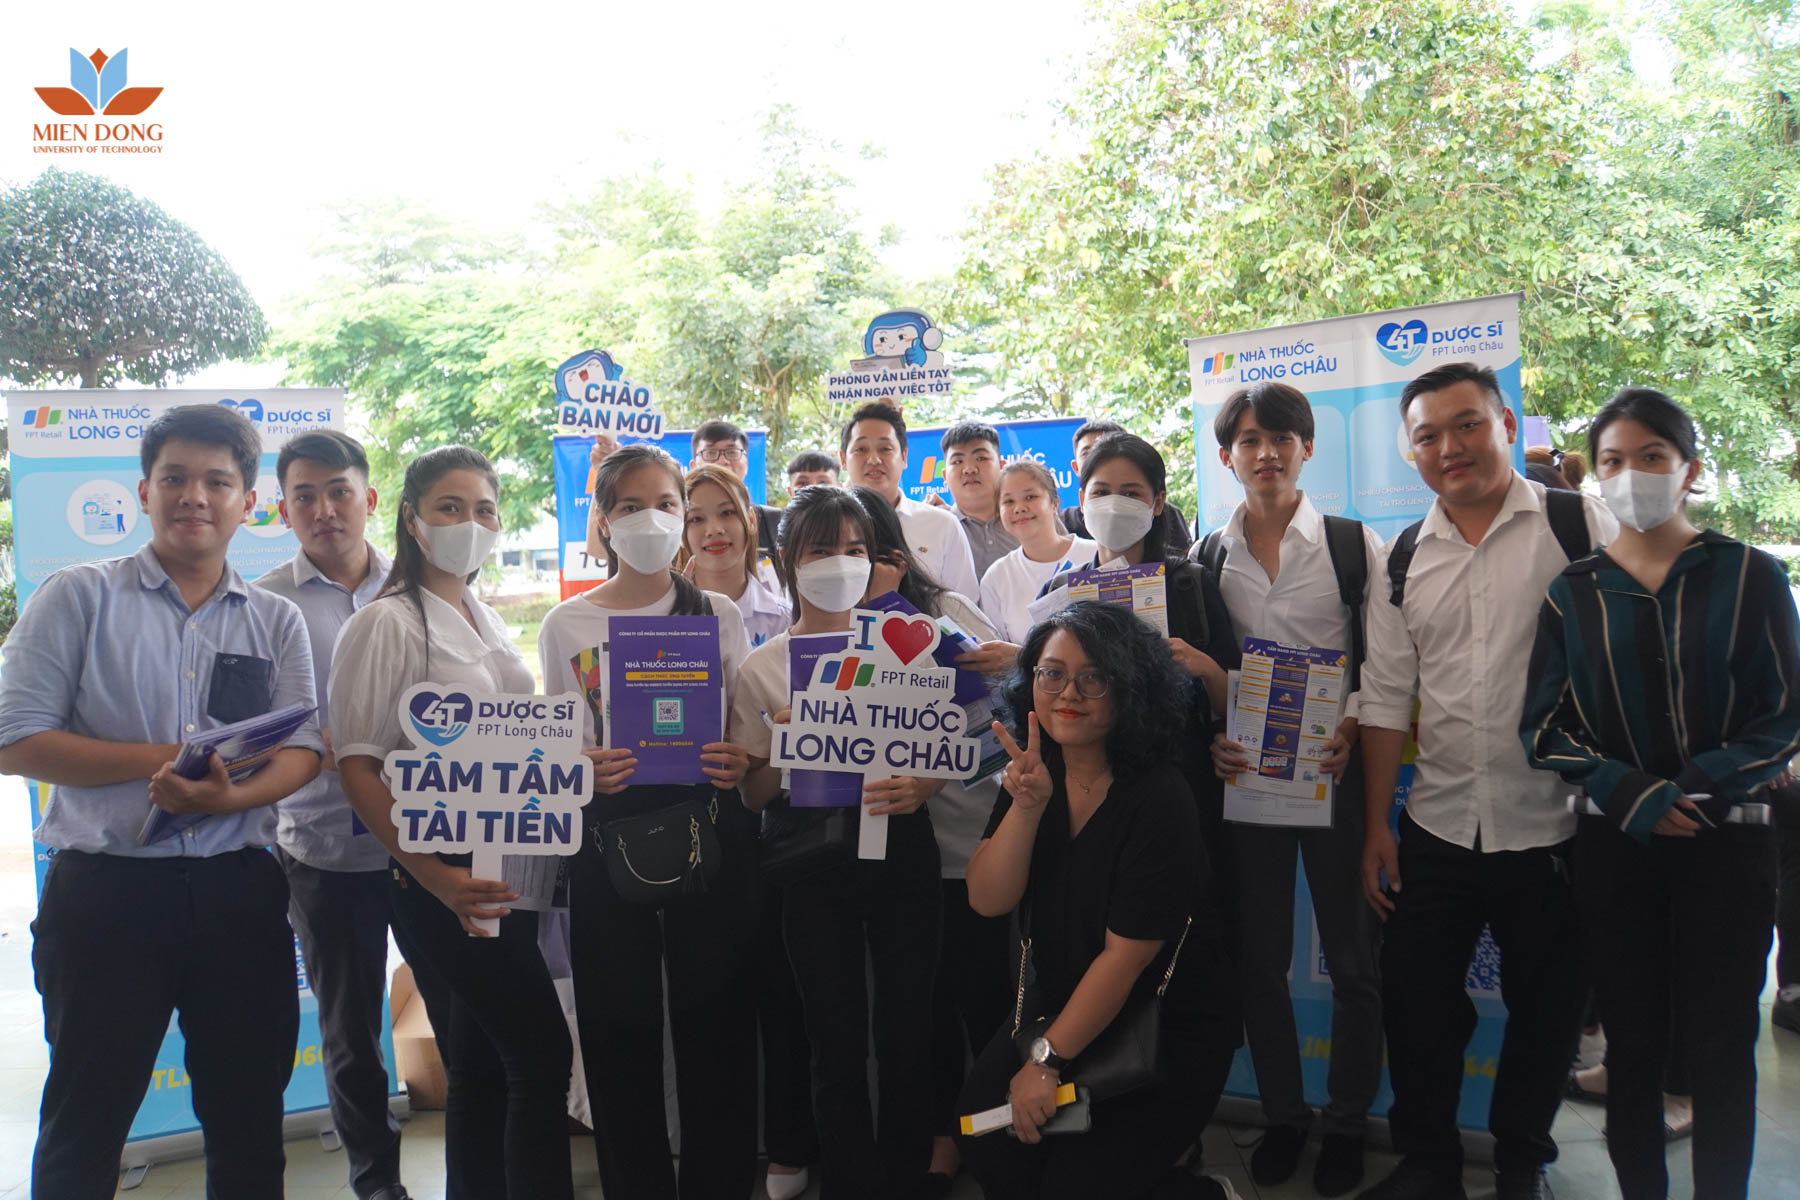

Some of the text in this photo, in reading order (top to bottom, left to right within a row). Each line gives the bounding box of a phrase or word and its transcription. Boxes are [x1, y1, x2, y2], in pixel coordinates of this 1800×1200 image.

[1431, 320, 1504, 343] DƯỢC SĨ
[1240, 339, 1314, 363] NHÀ THUỐC
[1432, 340, 1504, 357] FPT Long Châu
[928, 368, 950, 379] TAY
[1240, 355, 1337, 383] LONG CHÂU
[584, 380, 650, 408] CHÀO
[829, 388, 862, 401] NHẬN
[864, 386, 896, 398] NGAY
[898, 383, 926, 396] VIỆC
[68, 403, 151, 420] NHÀ THUỐC
[267, 408, 332, 425] DƯỢC SĨ
[562, 405, 662, 435] BẠN MỚI
[25, 431, 62, 439] FPT Retail
[69, 425, 121, 440] LONG
[267, 426, 283, 434] FPT
[910, 486, 924, 495] FPT
[574, 498, 590, 507] FPT
[854, 615, 876, 651] I
[625, 660, 640, 669] NHÀ
[668, 661, 688, 669] LONG
[881, 671, 949, 689] FPT Retail
[479, 701, 576, 723] DƯỢC SĨ
[800, 696, 960, 733] NHÀ THUỐC
[477, 724, 573, 740] FPT Long Châu
[780, 732, 975, 772] LONG CHÂU
[395, 748, 583, 795] TÂM TẦM
[402, 796, 571, 844] TÀI TIỀN
